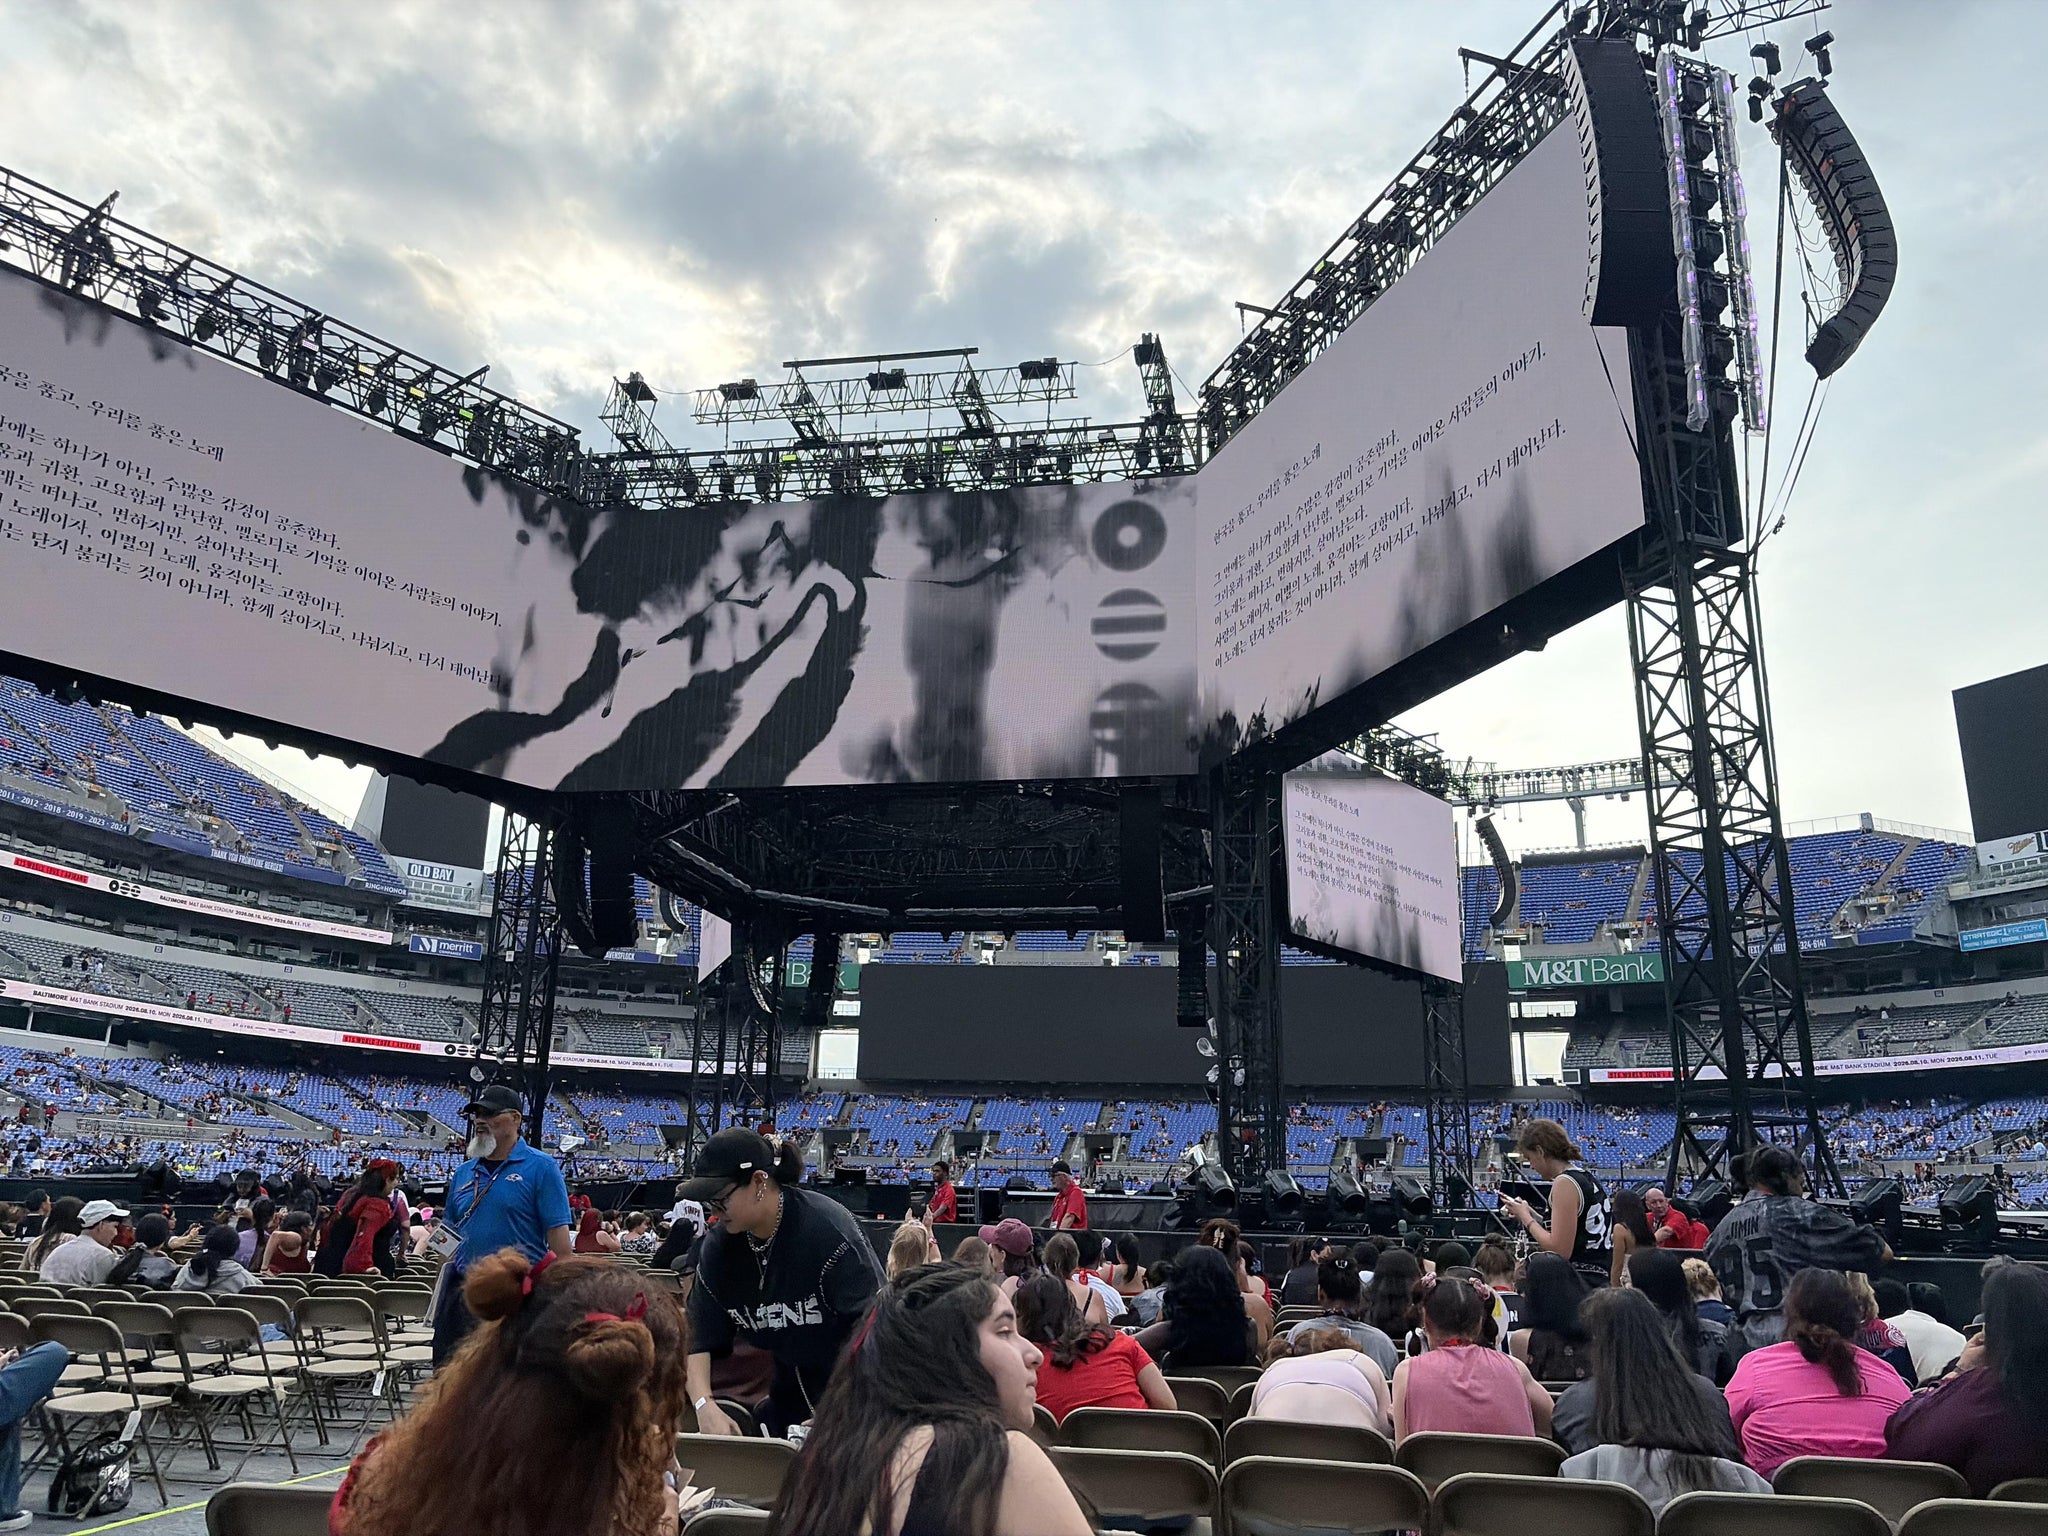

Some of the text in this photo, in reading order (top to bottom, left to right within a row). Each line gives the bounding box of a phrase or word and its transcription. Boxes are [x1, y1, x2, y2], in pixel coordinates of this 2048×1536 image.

[38, 381, 79, 410] 품고,
[88, 401, 142, 431] 우리를
[148, 423, 183, 446] 품은
[188, 439, 223, 462] 노래
[53, 438, 109, 467] 하나가
[116, 460, 154, 485] 아닌,
[162, 477, 215, 505] 수많은
[221, 497, 269, 524] 감정이
[275, 515, 340, 550] 공존한다.
[41, 458, 83, 486] 귀환,
[90, 476, 166, 511] 고요함과
[173, 504, 227, 534] 단단함,
[236, 525, 298, 556] 멜로디로
[304, 550, 349, 574] 기억을
[355, 567, 396, 590] 이어온
[400, 583, 455, 611] 사람들의
[461, 603, 501, 627] 이야기.
[42, 484, 102, 517] 떠나고,
[113, 507, 186, 544] 변하지만,
[194, 535, 281, 575] 살아남는다.
[9, 499, 344, 618] 노래이자, 이별의 노래, 움직이는 고향이다.
[32, 532, 68, 555] 단지
[75, 545, 131, 574] 불리는
[138, 565, 172, 587] 것이
[179, 579, 233, 607] 아니라,
[242, 596, 274, 618] 함께
[280, 609, 344, 641] 살아지고,
[419, 653, 444, 671] 다시
[21, 796, 38, 807] 2012
[44, 803, 61, 813] 2018
[66, 809, 83, 820] 2019
[89, 816, 105, 826] 2023
[110, 822, 127, 832] 2024
[365, 882, 380, 890] RING
[384, 886, 406, 895] HONOR
[410, 864, 453, 881] OLD BAY
[439, 941, 473, 953] merritt
[1522, 956, 1656, 986] M&T Bank
[33, 990, 68, 1001] BALTIMORE
[99, 1001, 124, 1010] STADIUM
[1731, 1216, 1759, 1239] JIMIN
[1719, 1237, 1782, 1308] 95
